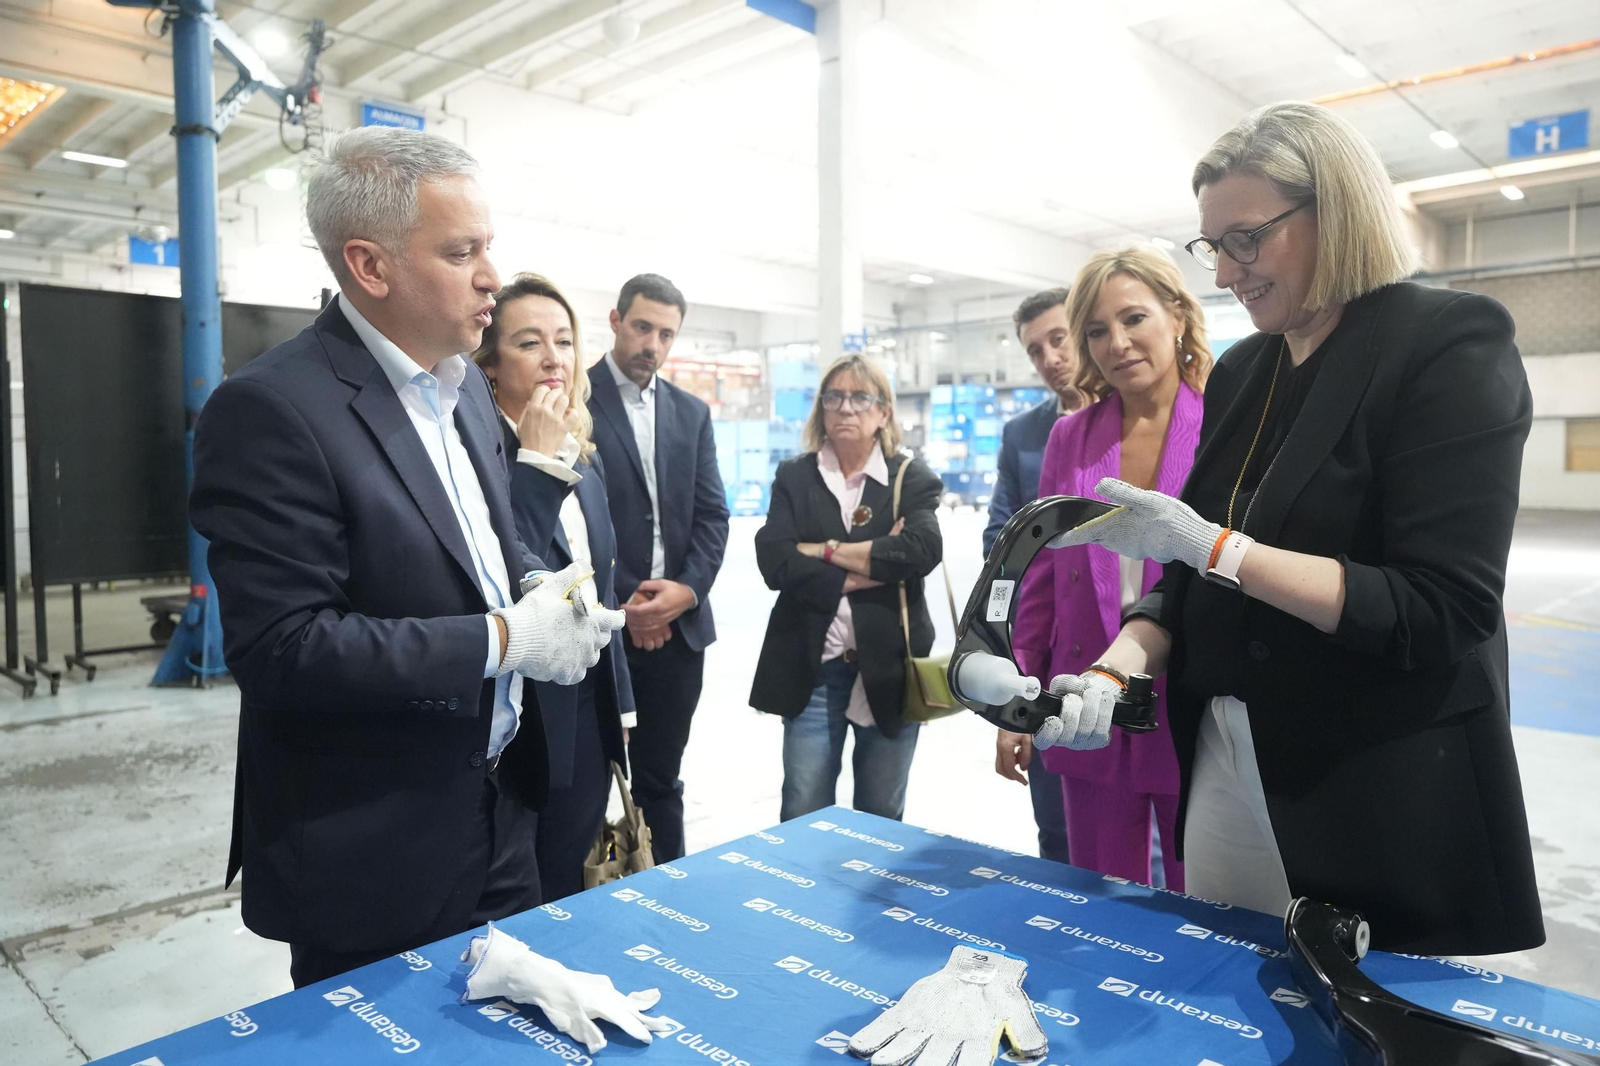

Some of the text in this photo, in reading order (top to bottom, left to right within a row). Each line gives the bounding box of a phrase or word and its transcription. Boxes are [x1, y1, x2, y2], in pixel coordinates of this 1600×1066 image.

[1535, 126, 1560, 153] H
[833, 825, 905, 852] Gestamp
[742, 858, 817, 889] Gestamp
[868, 867, 950, 897] Gestamp
[1000, 874, 1088, 905] Gestamp
[637, 898, 710, 932] Gestamp
[772, 907, 855, 943] Gestamp
[1060, 926, 1165, 963] Gestamp
[653, 955, 738, 1000] Gestamp
[348, 1002, 421, 1054] Gestamp
[1139, 989, 1263, 1039] Gestamp
[1502, 1015, 1600, 1051] tamp
